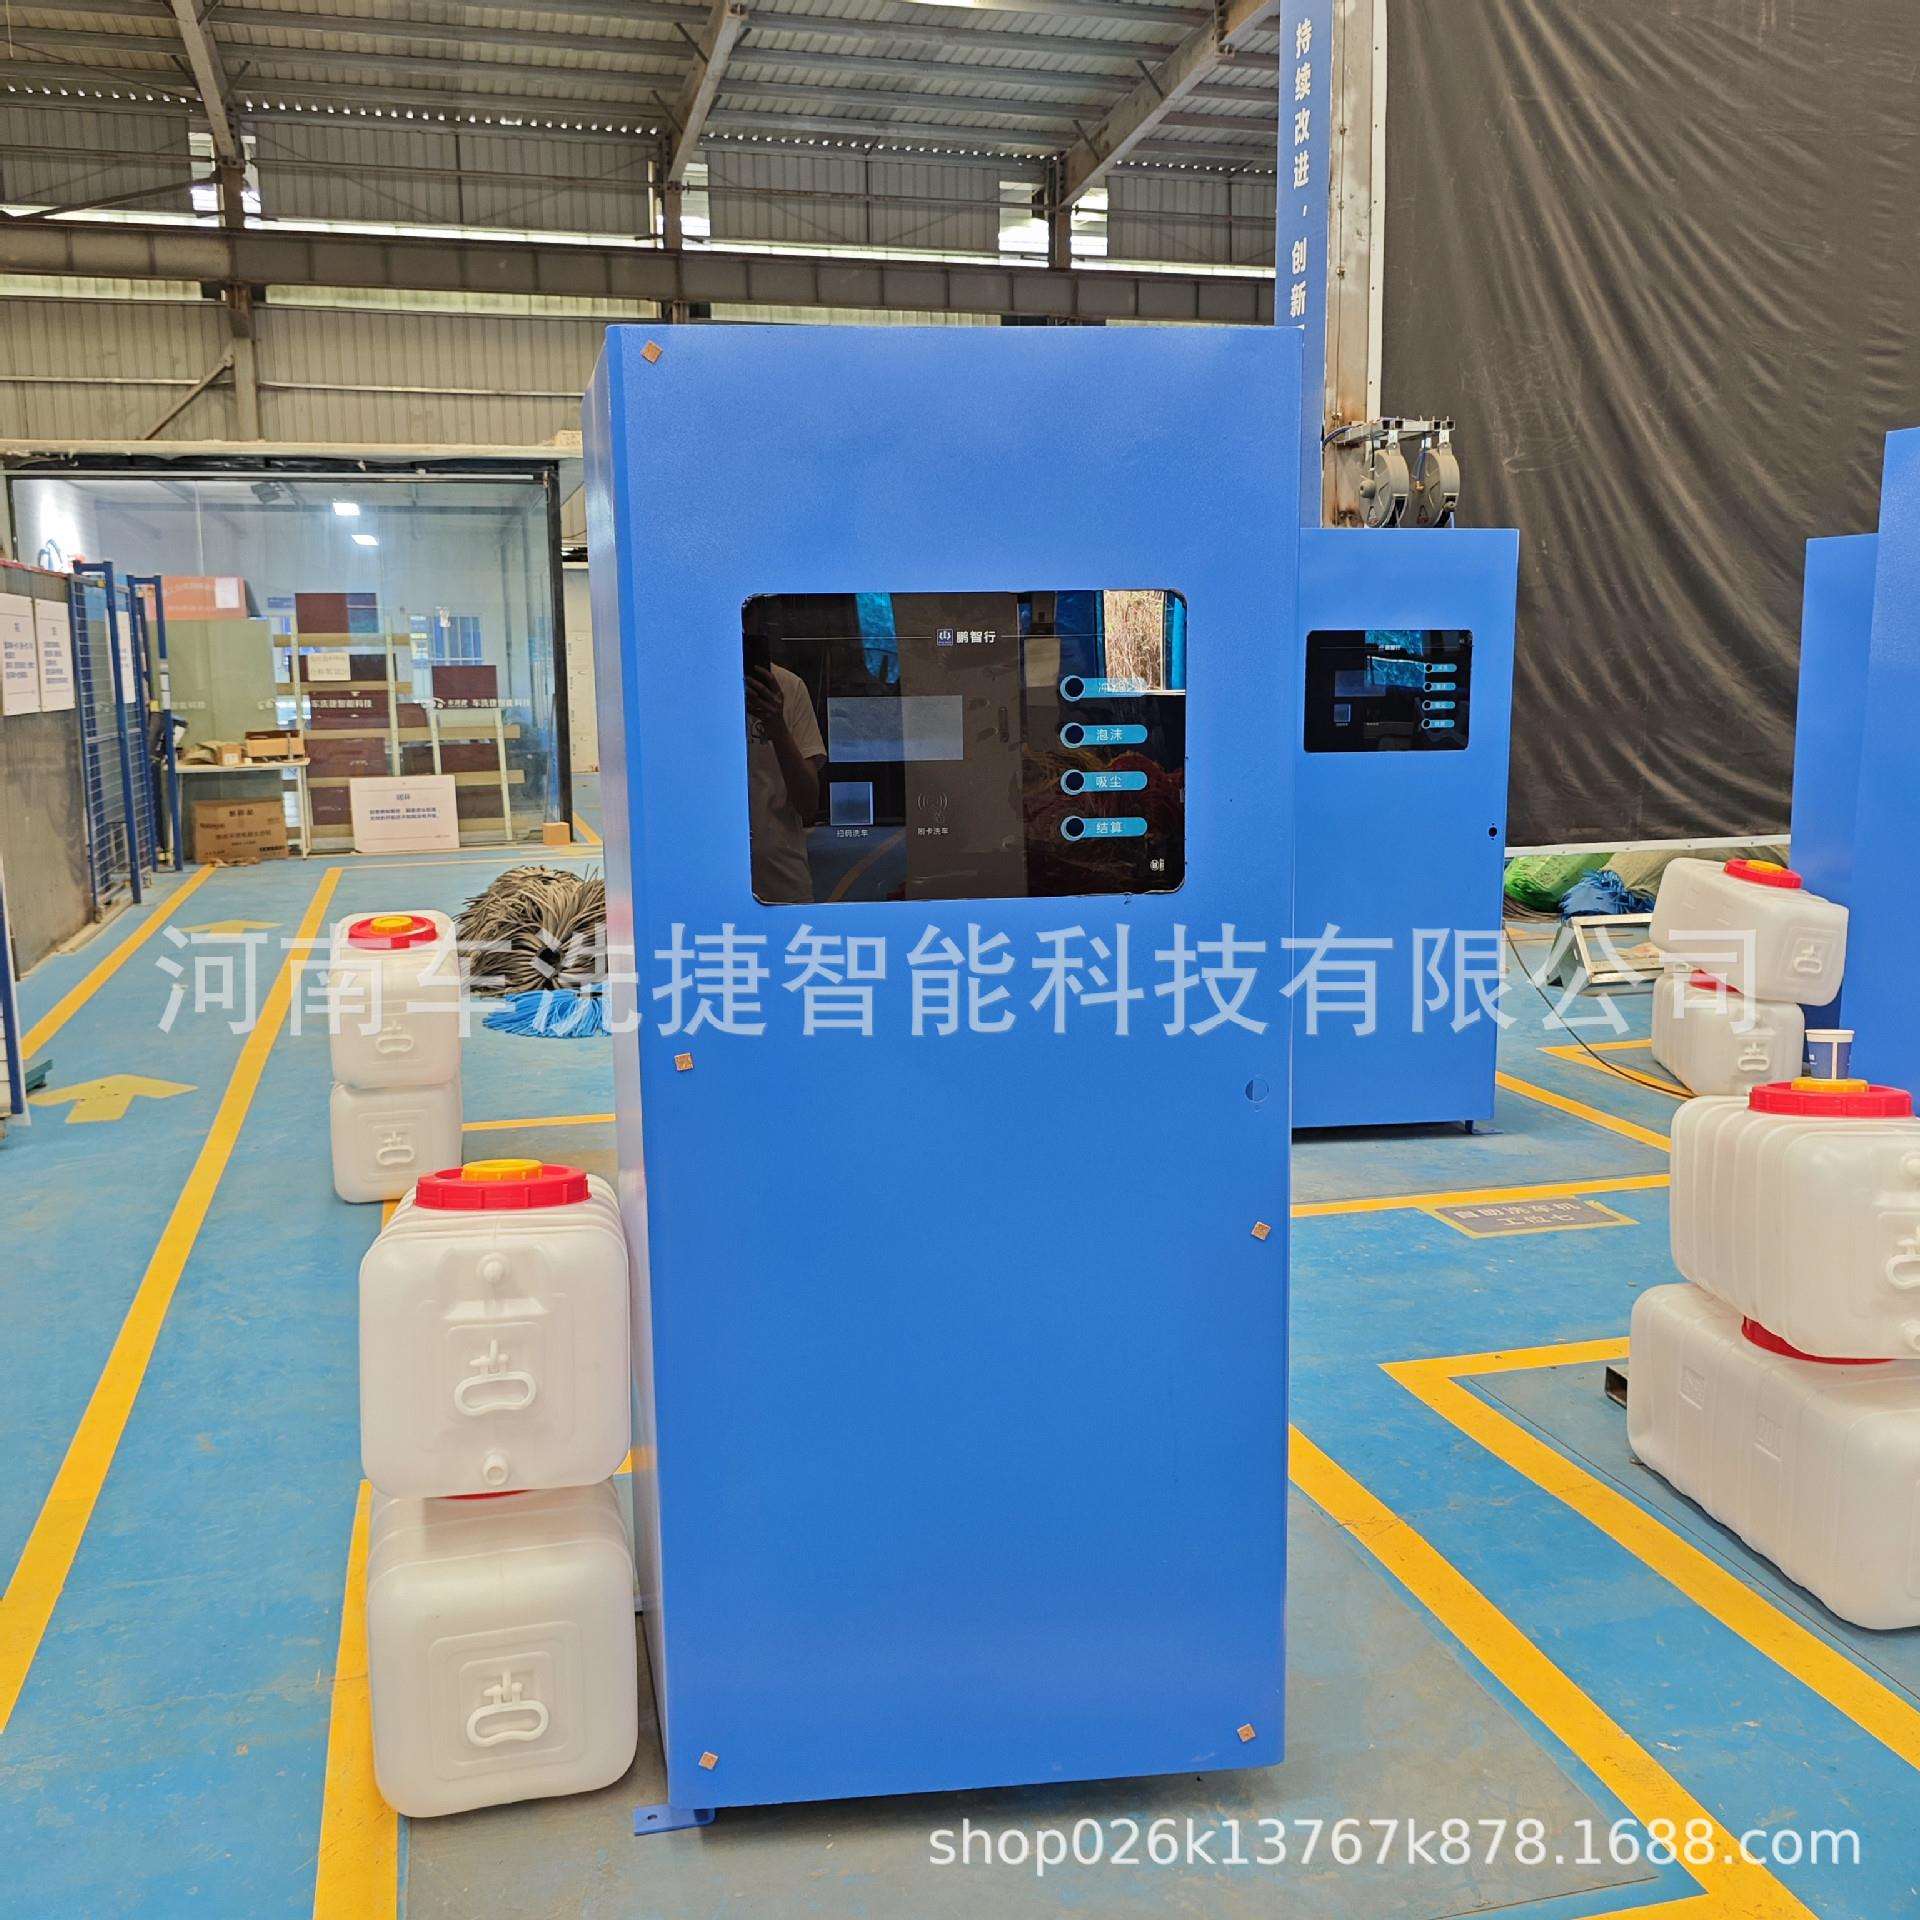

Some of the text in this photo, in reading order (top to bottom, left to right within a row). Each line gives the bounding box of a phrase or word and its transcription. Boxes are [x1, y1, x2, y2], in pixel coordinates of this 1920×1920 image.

[956, 629, 996, 644] 鹏智行
[1096, 728, 1123, 742] 泡沫
[1095, 774, 1122, 788] 吸尘
[1096, 820, 1122, 834] 结算
